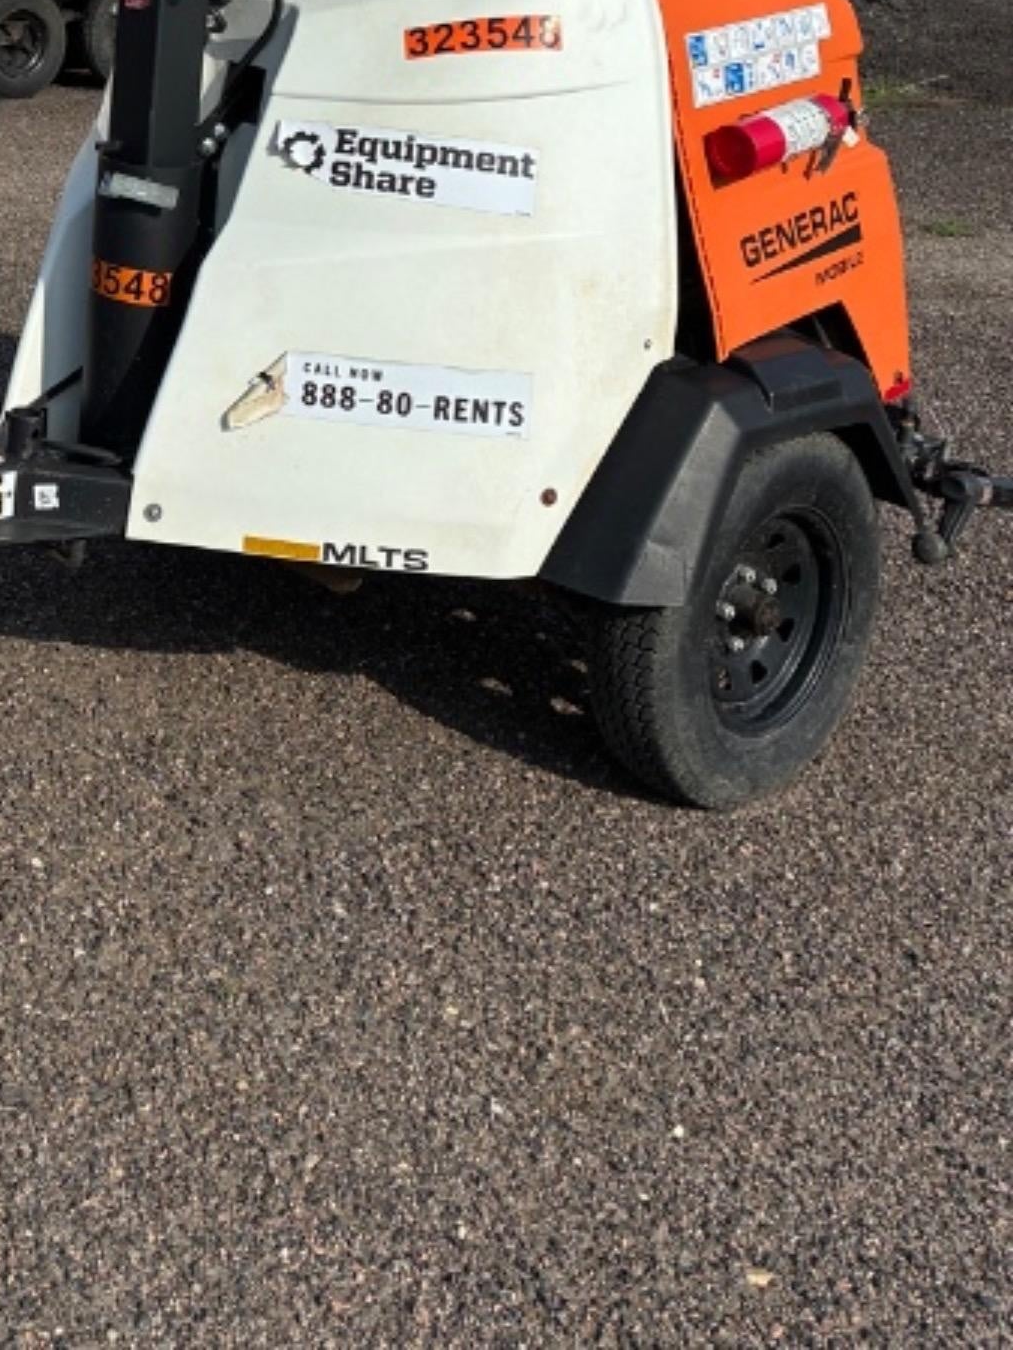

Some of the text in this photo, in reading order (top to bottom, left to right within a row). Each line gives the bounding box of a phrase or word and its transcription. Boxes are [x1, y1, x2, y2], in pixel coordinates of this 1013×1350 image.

[408, 15, 562, 56] 323548
[334, 129, 537, 180] Equipment
[330, 161, 437, 198] Share
[740, 191, 859, 267] GENERAC
[302, 361, 385, 382] CALL NOW
[301, 380, 525, 428] 888-80-RENTS
[323, 542, 430, 572] MLTS
